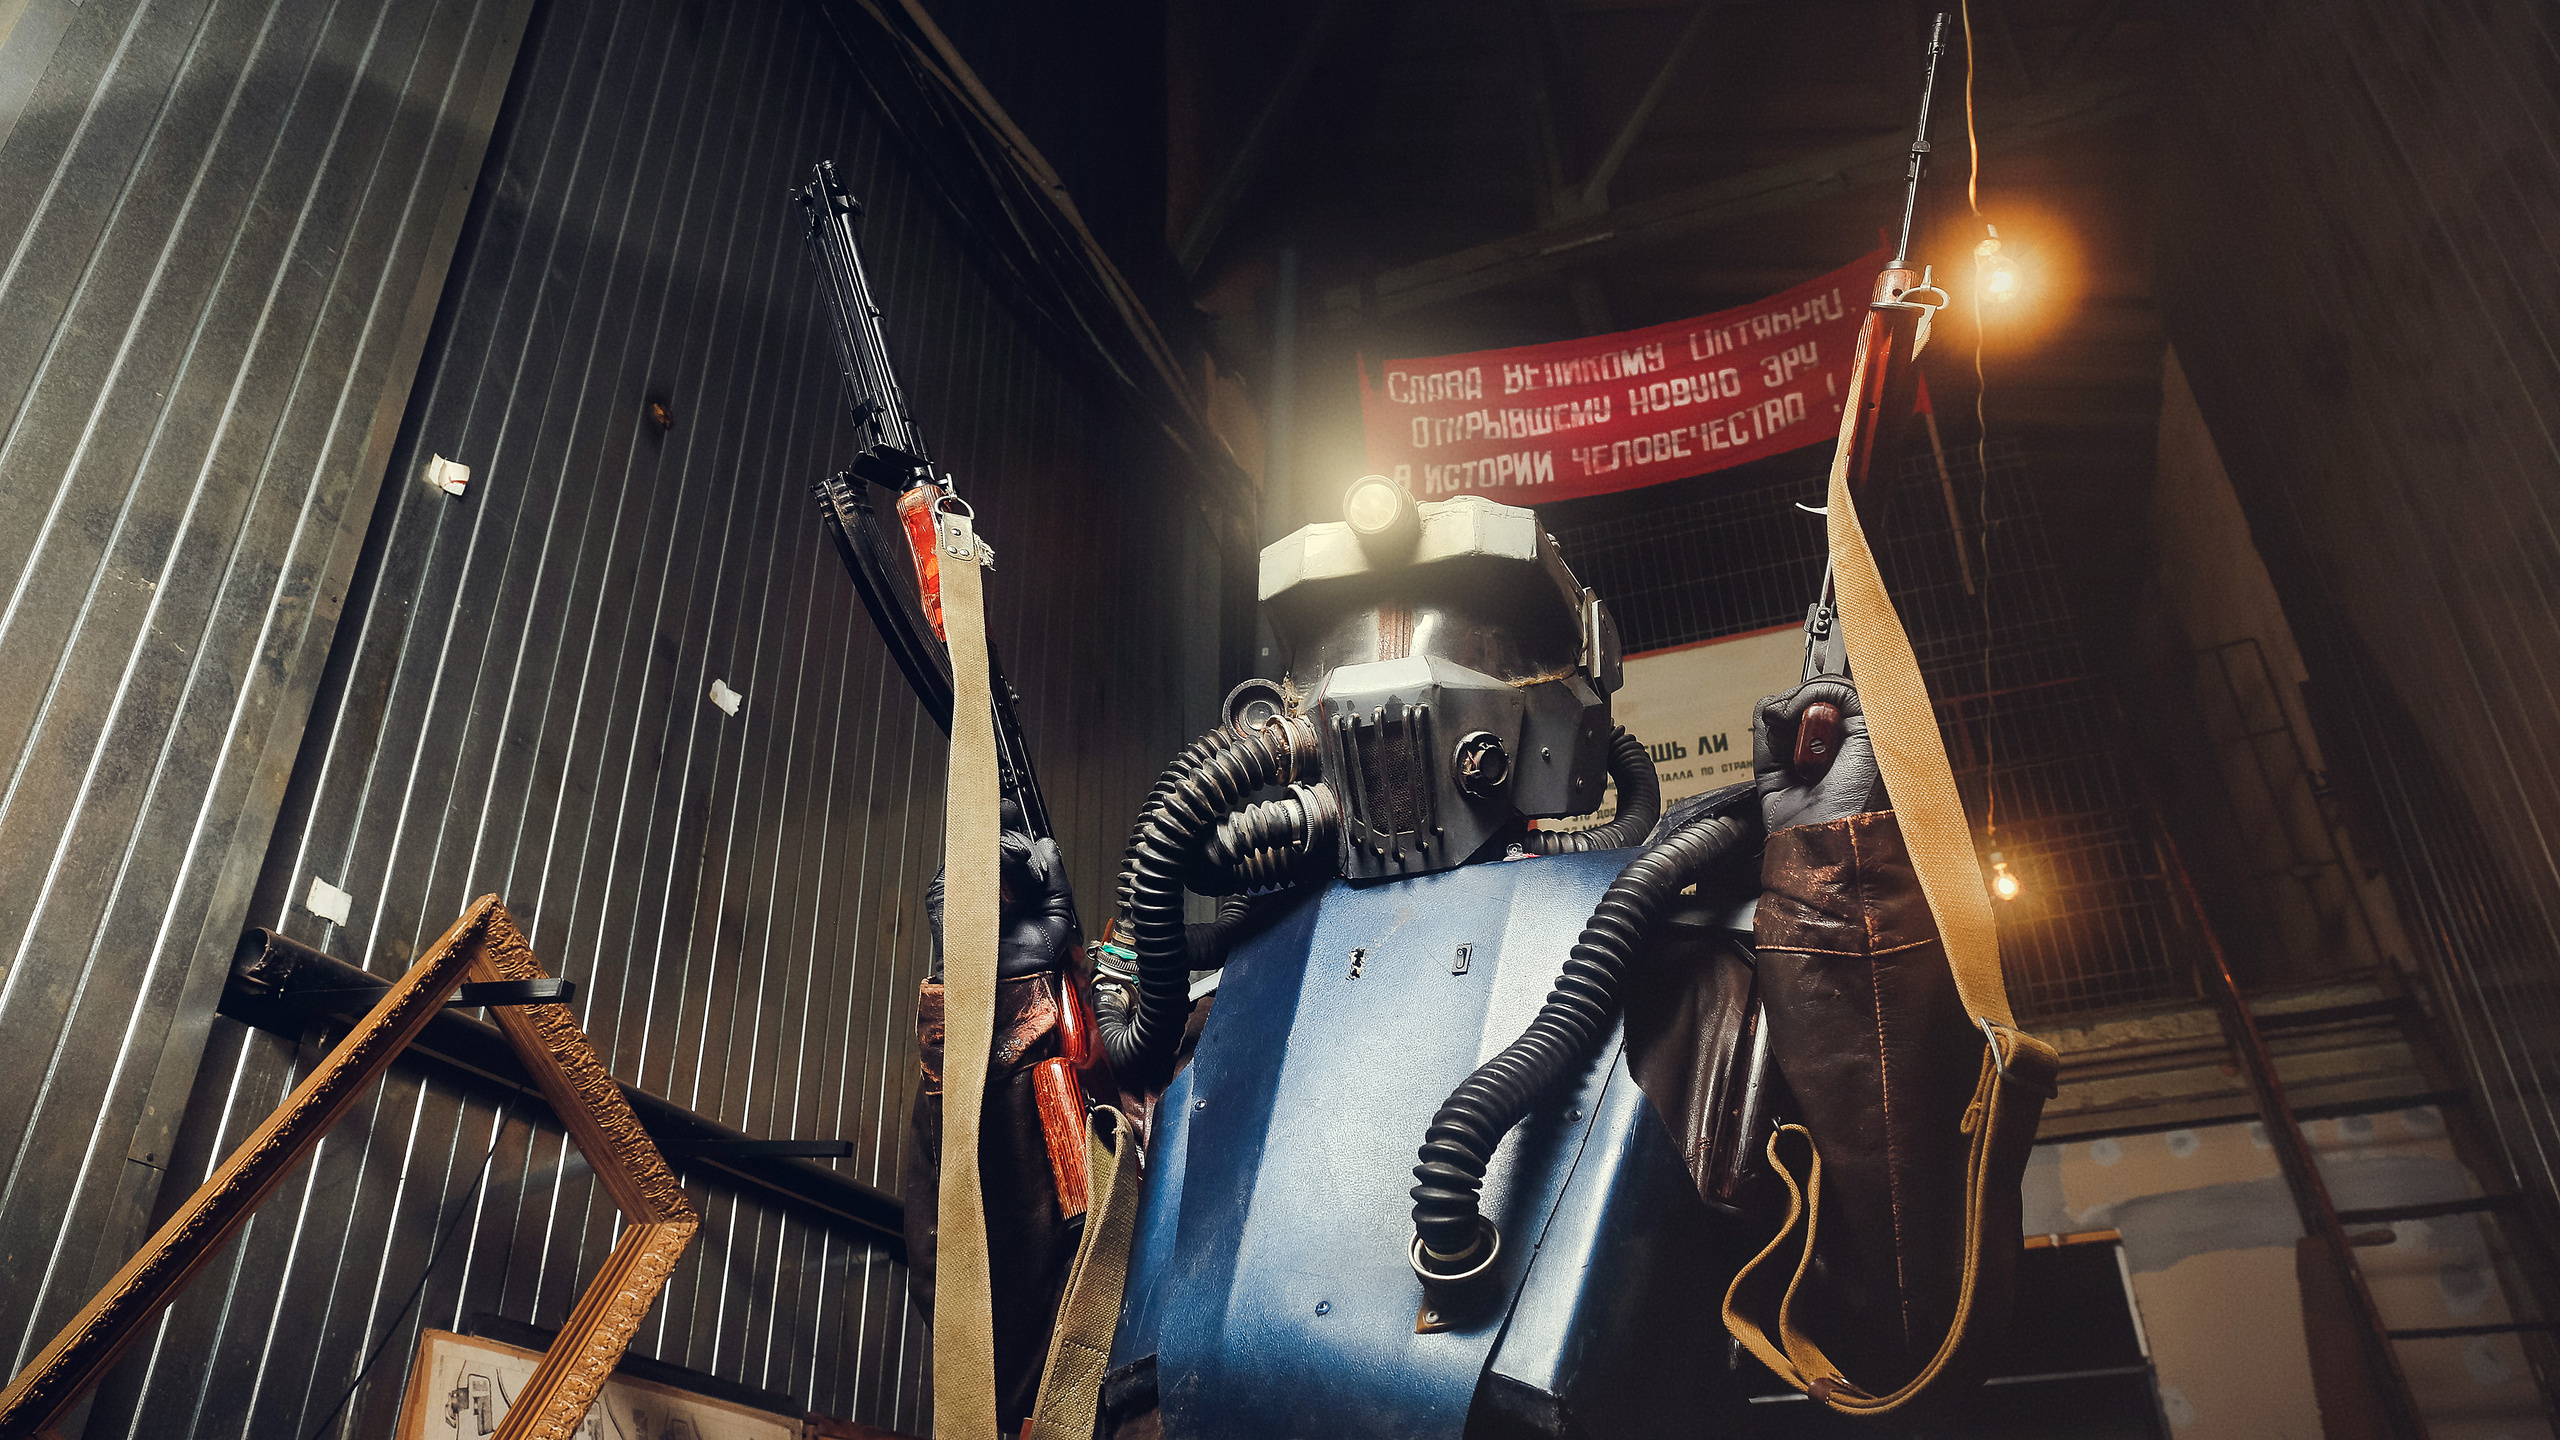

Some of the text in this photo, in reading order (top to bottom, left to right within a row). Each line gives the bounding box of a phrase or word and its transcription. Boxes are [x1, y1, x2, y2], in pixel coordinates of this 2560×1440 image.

[1387, 366, 1483, 404] СЛАВА
[1502, 342, 1666, 395] ВЕЛИКОМУ
[1411, 340, 1820, 449] ОТКРЫВШЕМУ НОВУЮ ЭРУ
[1424, 450, 1556, 495] ИСТОРИИ
[1571, 391, 1808, 477] ЧЕЛОВЕЧЕСТВА
[1645, 733, 1729, 762] ШЬ ЛИ
[1700, 766, 1715, 777] ПО
